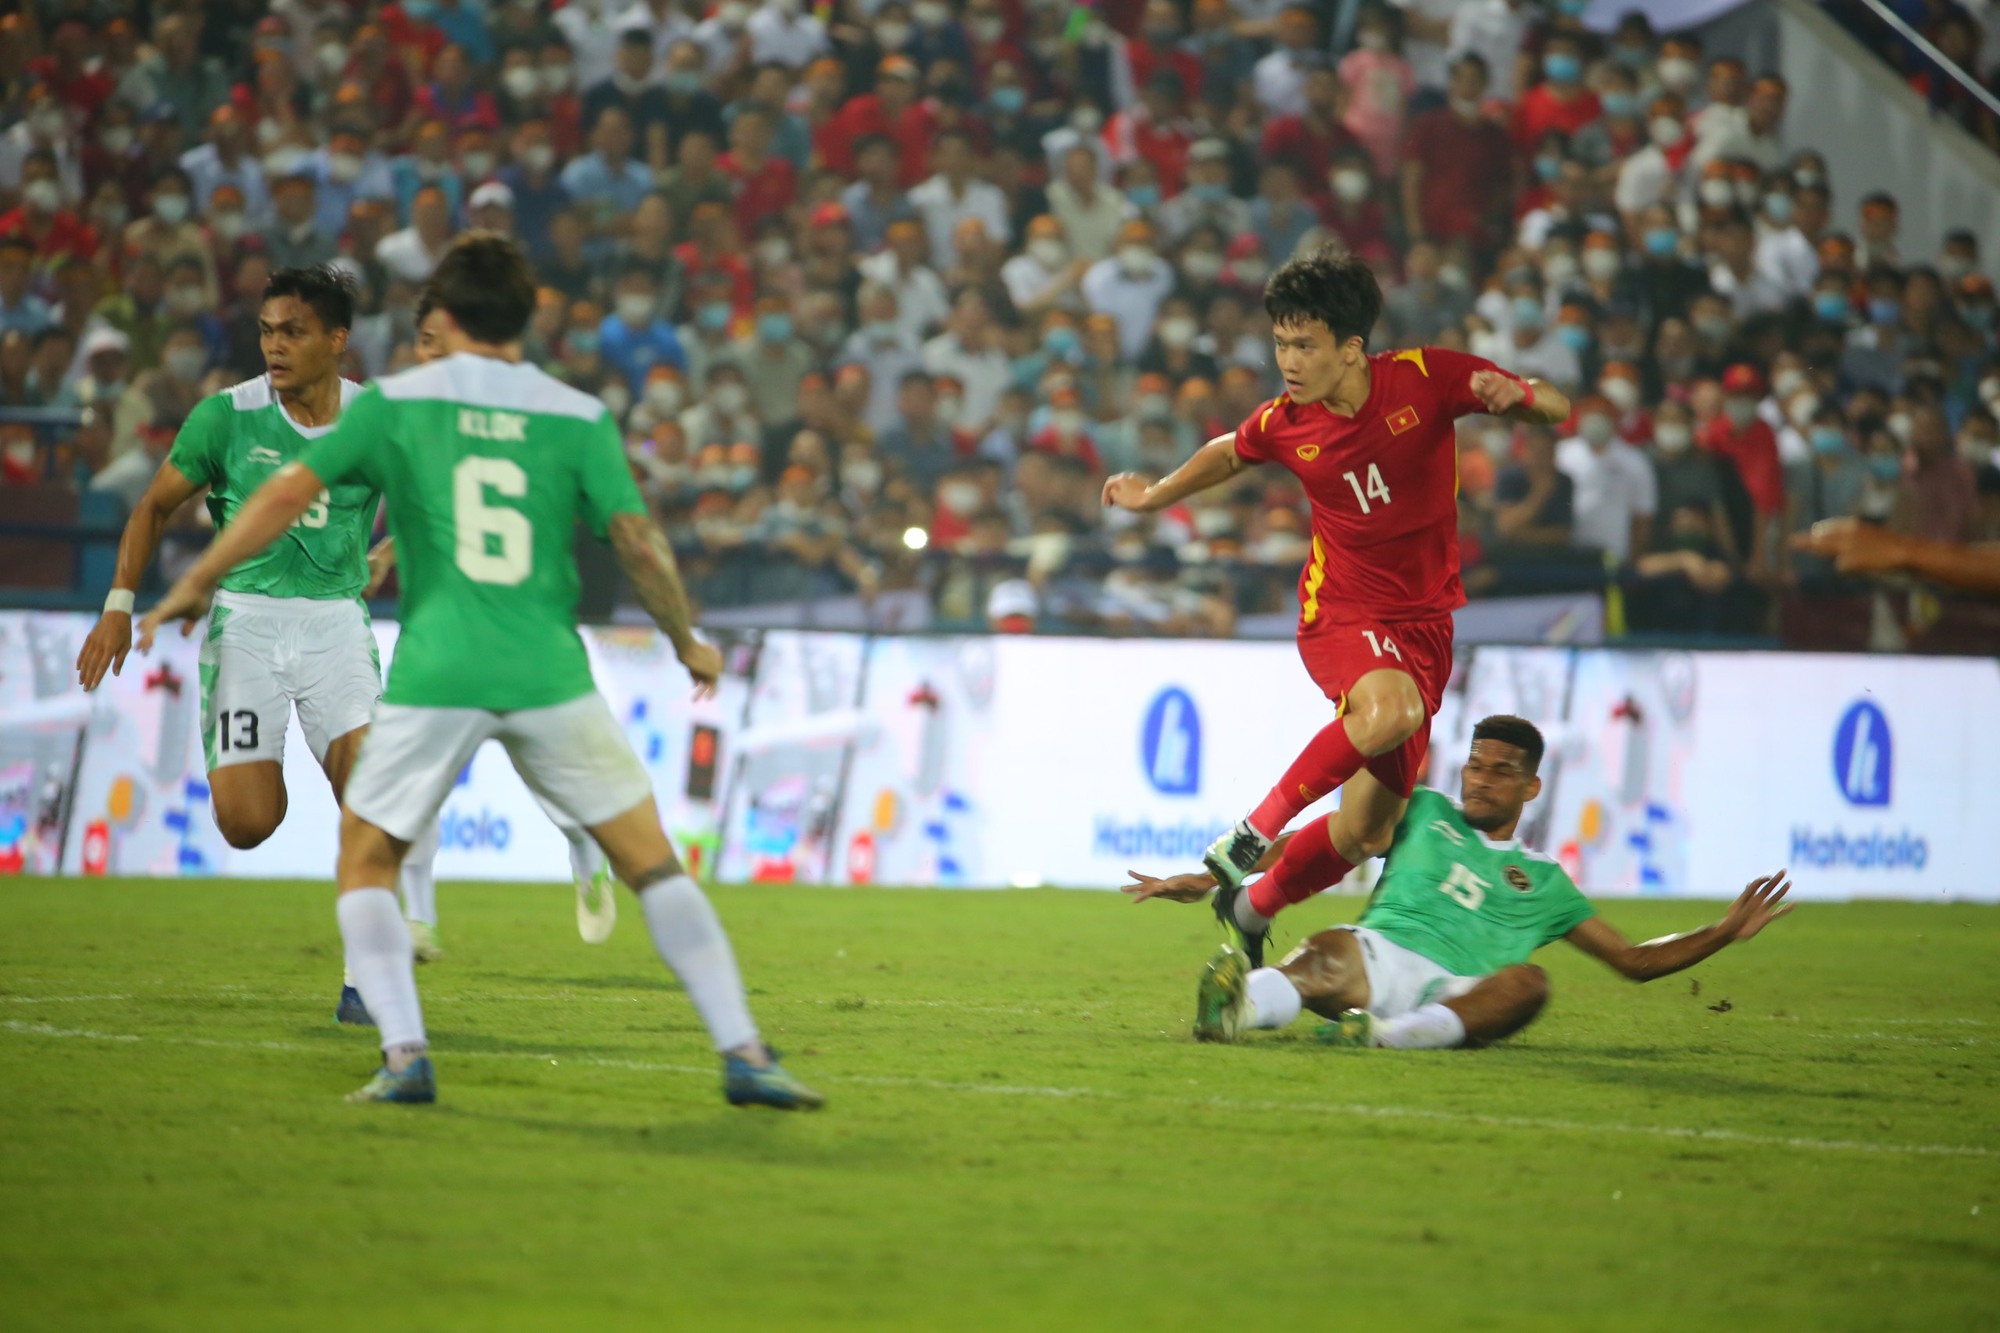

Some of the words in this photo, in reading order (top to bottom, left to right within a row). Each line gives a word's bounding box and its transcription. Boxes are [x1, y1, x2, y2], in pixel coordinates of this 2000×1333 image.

[289, 488, 330, 529] 3
[1342, 462, 1391, 514] 14
[453, 455, 532, 586] 6
[1362, 629, 1402, 662] 14
[220, 709, 259, 752] 13
[1791, 827, 1928, 872] Hahalolo
[1439, 862, 1492, 911] 15
